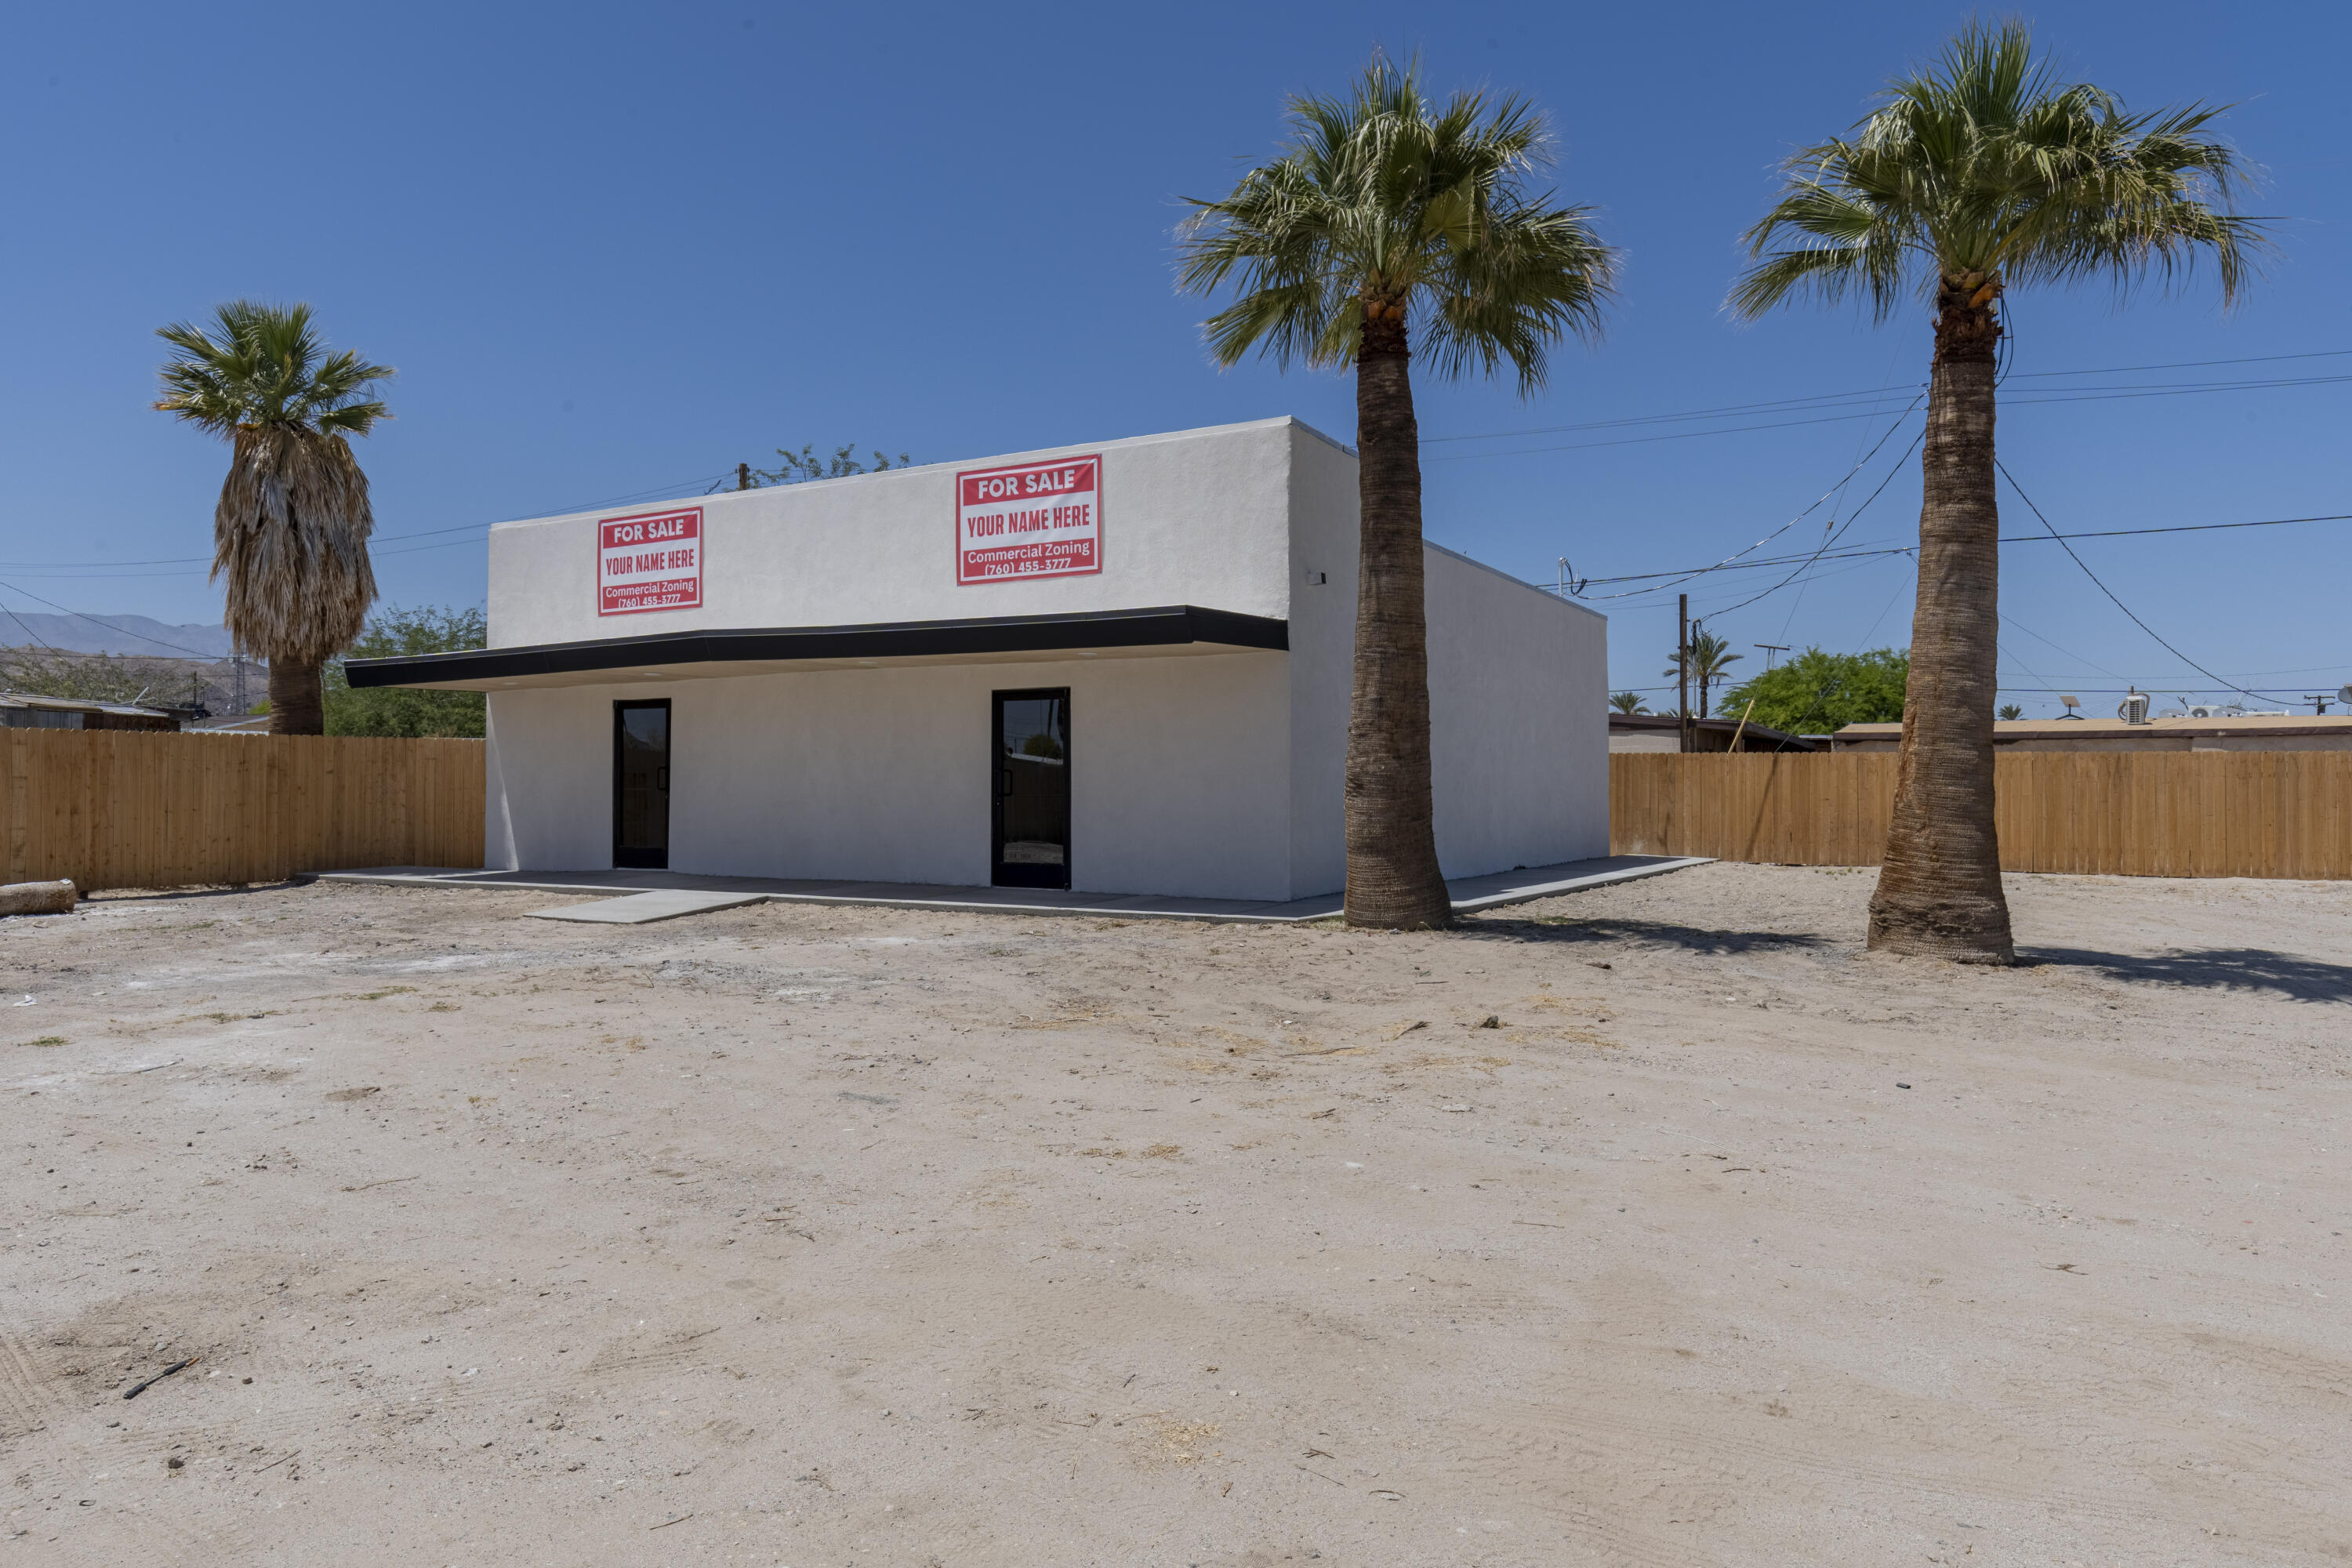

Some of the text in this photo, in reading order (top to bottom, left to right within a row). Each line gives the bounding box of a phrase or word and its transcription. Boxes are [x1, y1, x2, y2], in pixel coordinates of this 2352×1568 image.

[978, 470, 1075, 499] FOR SALE
[614, 519, 684, 543] FOR SALE
[967, 504, 1090, 538] YOUR NAME HERE
[606, 549, 694, 575] YOUR NAME HERE
[968, 542, 1090, 564] Commercial Zoning
[985, 557, 1071, 575] (760) 455-3777
[606, 580, 694, 597] Commercial Zoning
[619, 594, 681, 608] (760) 455-3777
